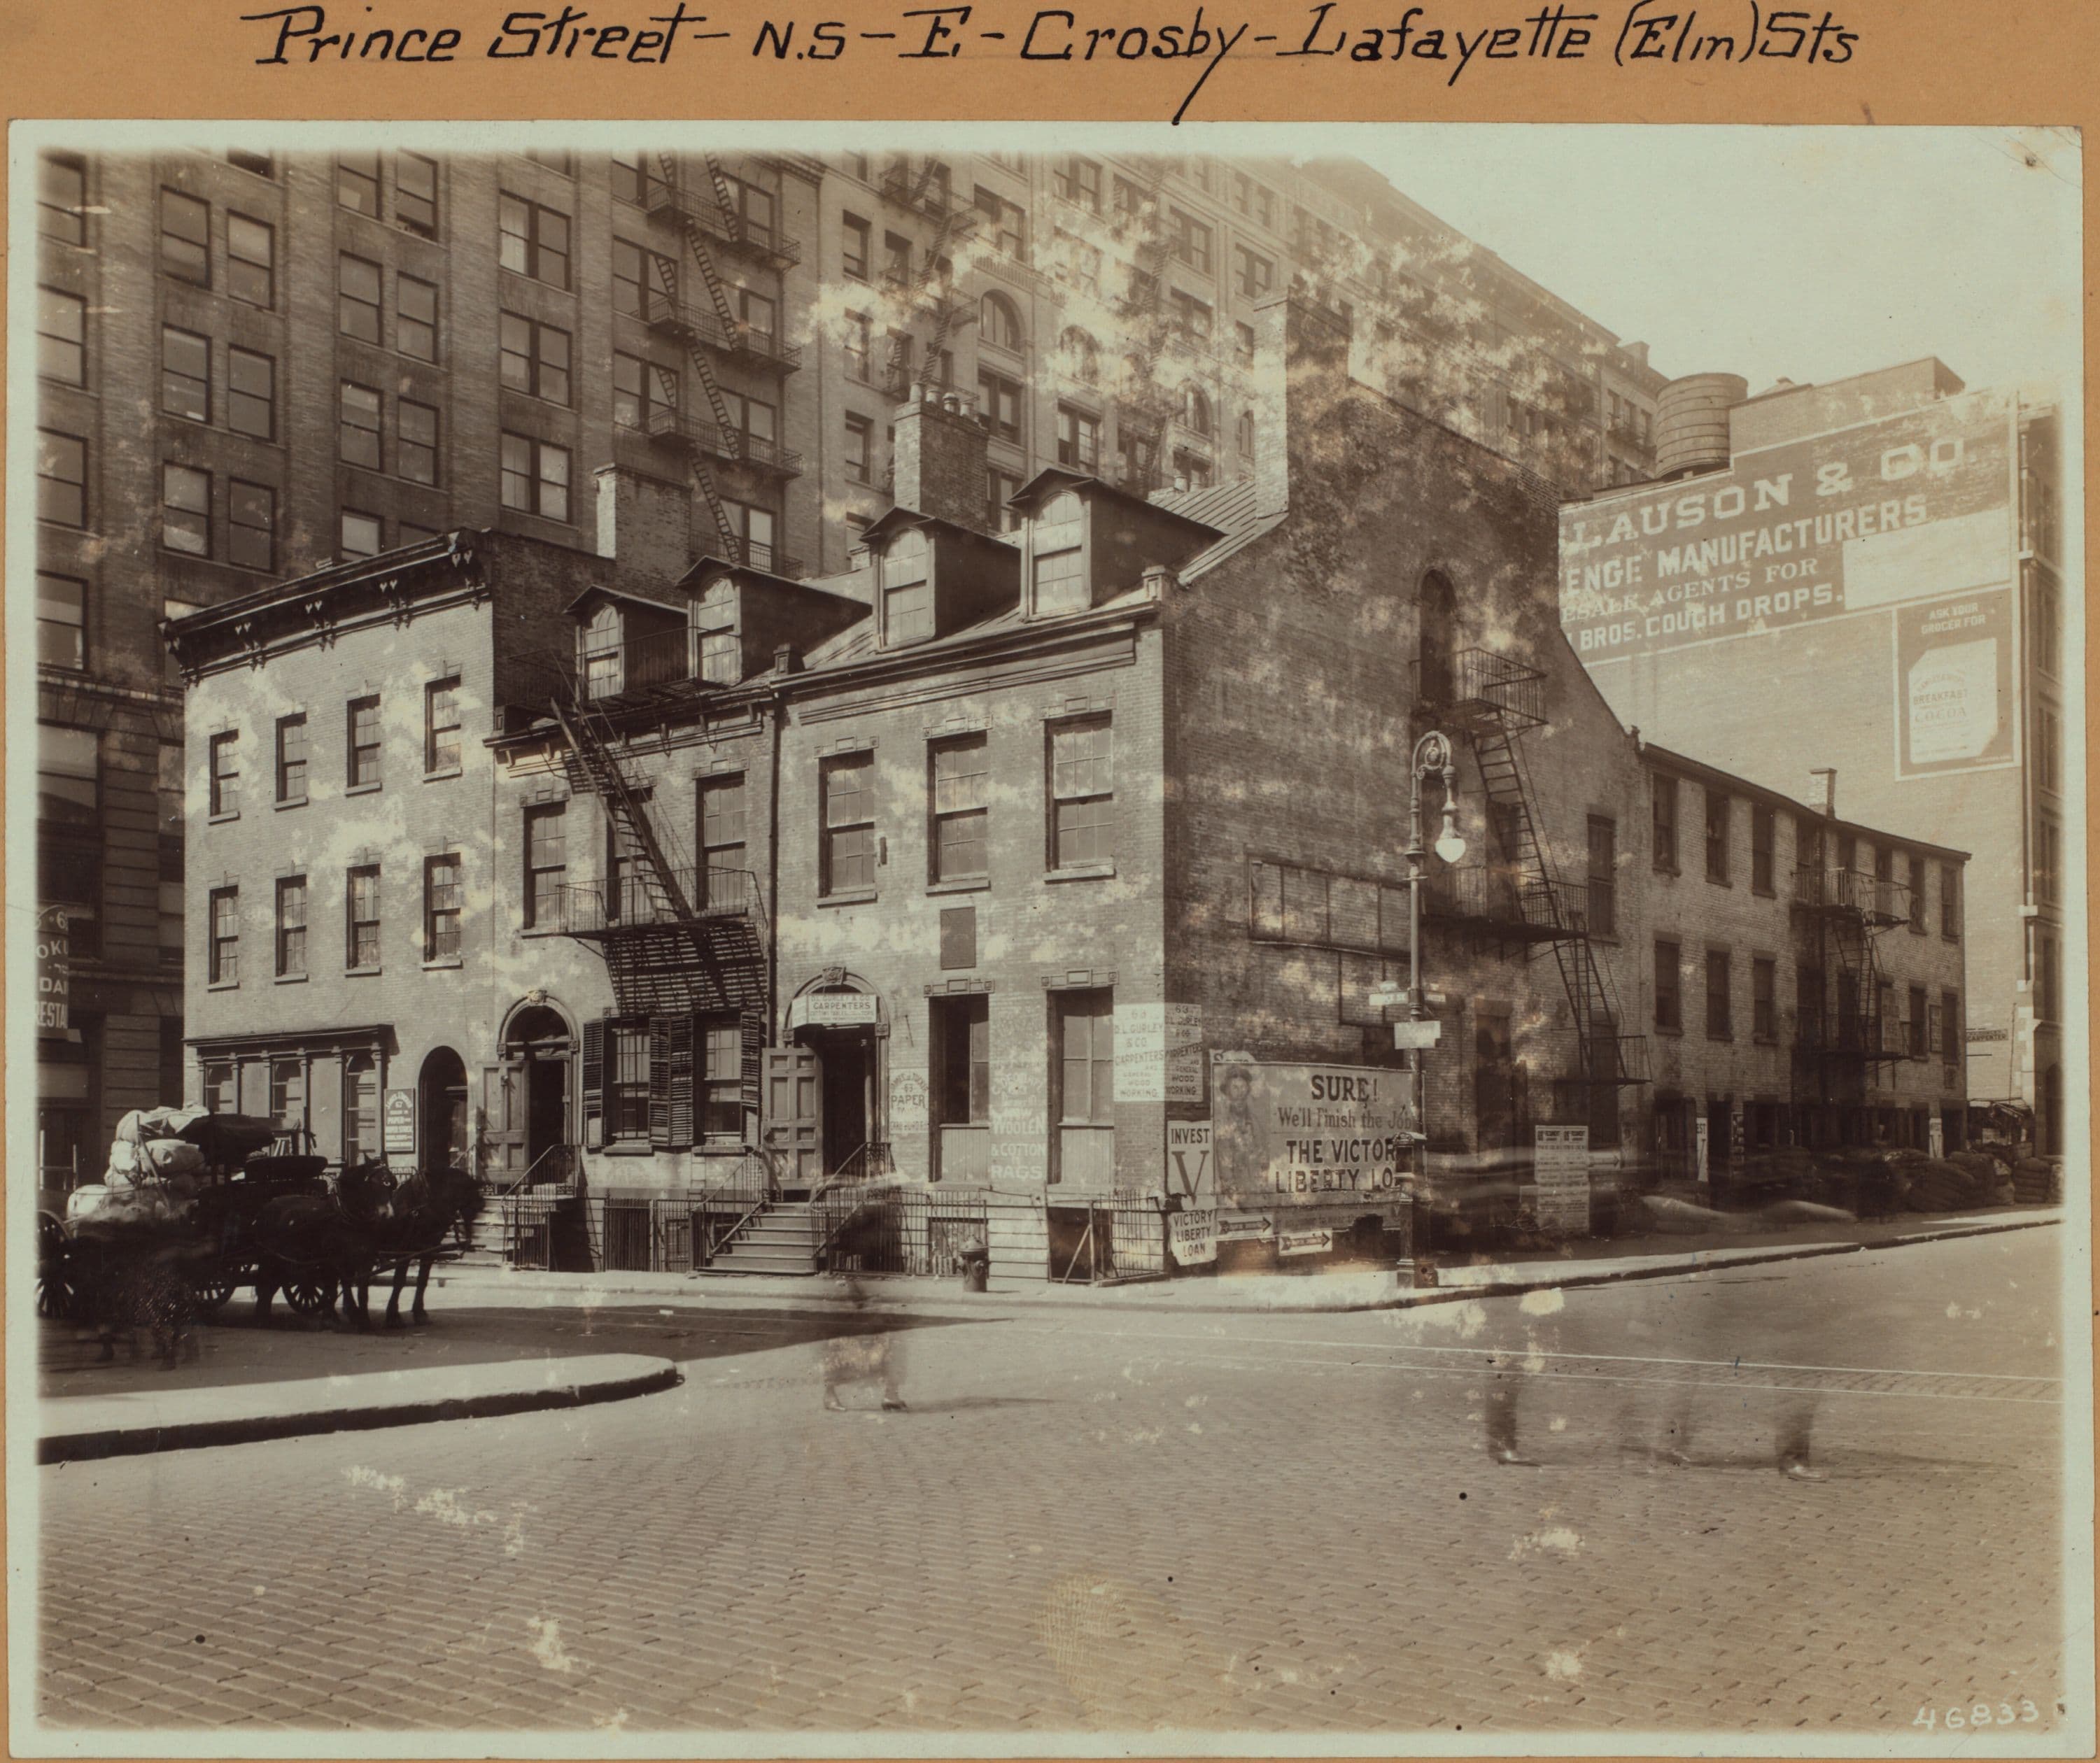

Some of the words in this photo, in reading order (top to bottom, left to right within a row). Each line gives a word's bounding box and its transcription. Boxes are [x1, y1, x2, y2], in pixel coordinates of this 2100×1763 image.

[240, 5, 459, 66] Prince
[488, 2, 707, 65] Street
[1020, 8, 1248, 125] Crosby
[1276, 2, 1598, 87] Lafayette
[1816, 461, 1854, 497] &
[1559, 555, 1642, 595] ENGE
[1658, 493, 1927, 577] MANUFACTURERS
[1649, 571, 1751, 607] AGENTS
[1765, 558, 1818, 584] FOR
[1580, 621, 1642, 651] BROS.
[1645, 603, 1726, 637] COUGH
[1736, 582, 1844, 621] DROPS.
[1929, 607, 1950, 621] ASK
[1952, 602, 1979, 616] YOUR
[1921, 618, 1961, 635] GROCER
[1964, 615, 1986, 628] FOR
[812, 1002, 871, 1010] CARPENTERS
[1114, 1049, 1164, 1065] CARPENTERS
[1311, 1075, 1378, 1103] SURE!
[890, 1094, 926, 1109] PAPER
[992, 1118, 1045, 1135] WOOLEN
[1277, 1107, 1312, 1128] We'll
[1316, 1107, 1356, 1128] Finish
[1361, 1110, 1383, 1129] the
[1171, 1128, 1210, 1145] INVEST
[1001, 1142, 1045, 1156] COTTON
[1285, 1140, 1323, 1163] THE
[1330, 1138, 1397, 1163] VICTOR
[991, 1165, 1043, 1181] RAGS
[1171, 1149, 1210, 1206] V
[1276, 1168, 1360, 1194] LIBERTY
[1372, 1168, 1398, 1191] LO
[1173, 1209, 1213, 1228] VICTORY
[1176, 1226, 1211, 1243] LIBERTY
[1183, 1242, 1206, 1257] LOAN
